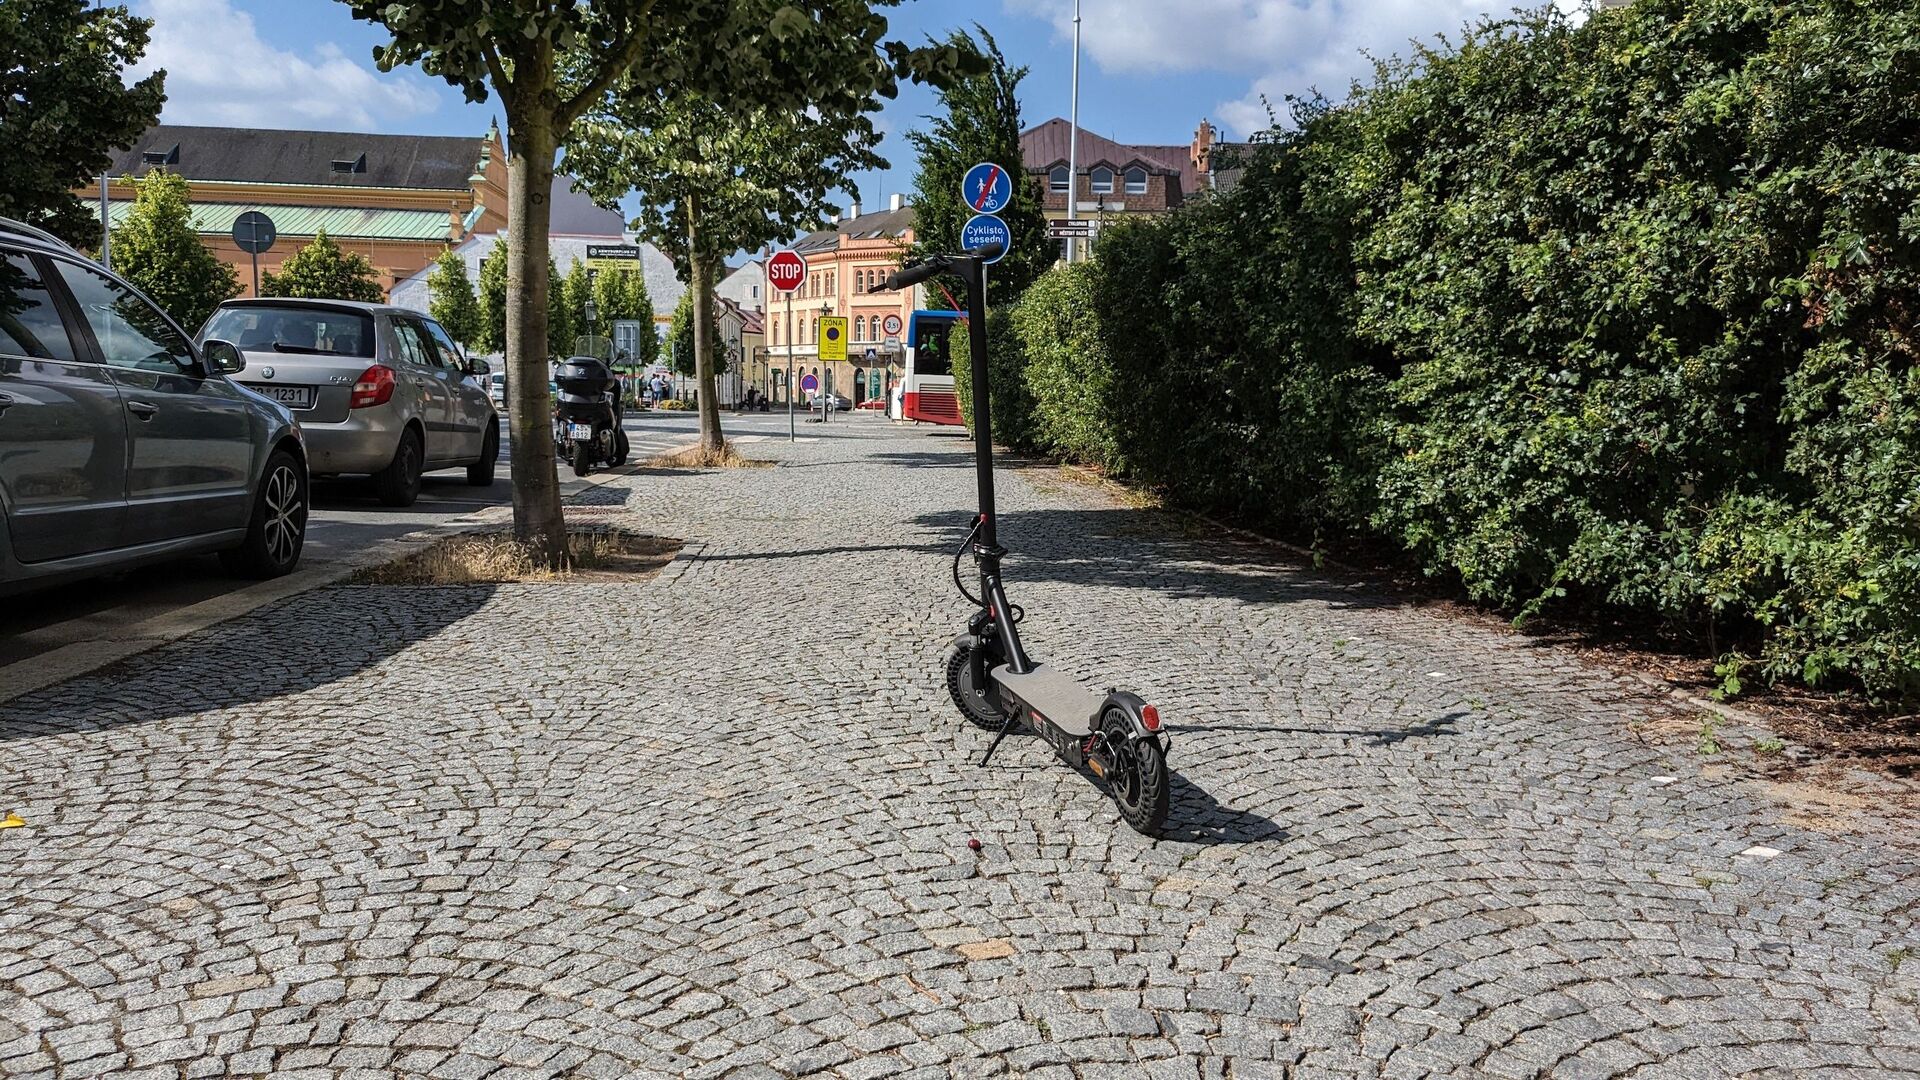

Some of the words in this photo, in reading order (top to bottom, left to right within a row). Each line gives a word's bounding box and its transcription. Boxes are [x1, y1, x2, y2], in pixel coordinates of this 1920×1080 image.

[967, 226, 1005, 236] Cyklisto,
[771, 263, 801, 279] STOP
[823, 318, 843, 326] ZÓNA
